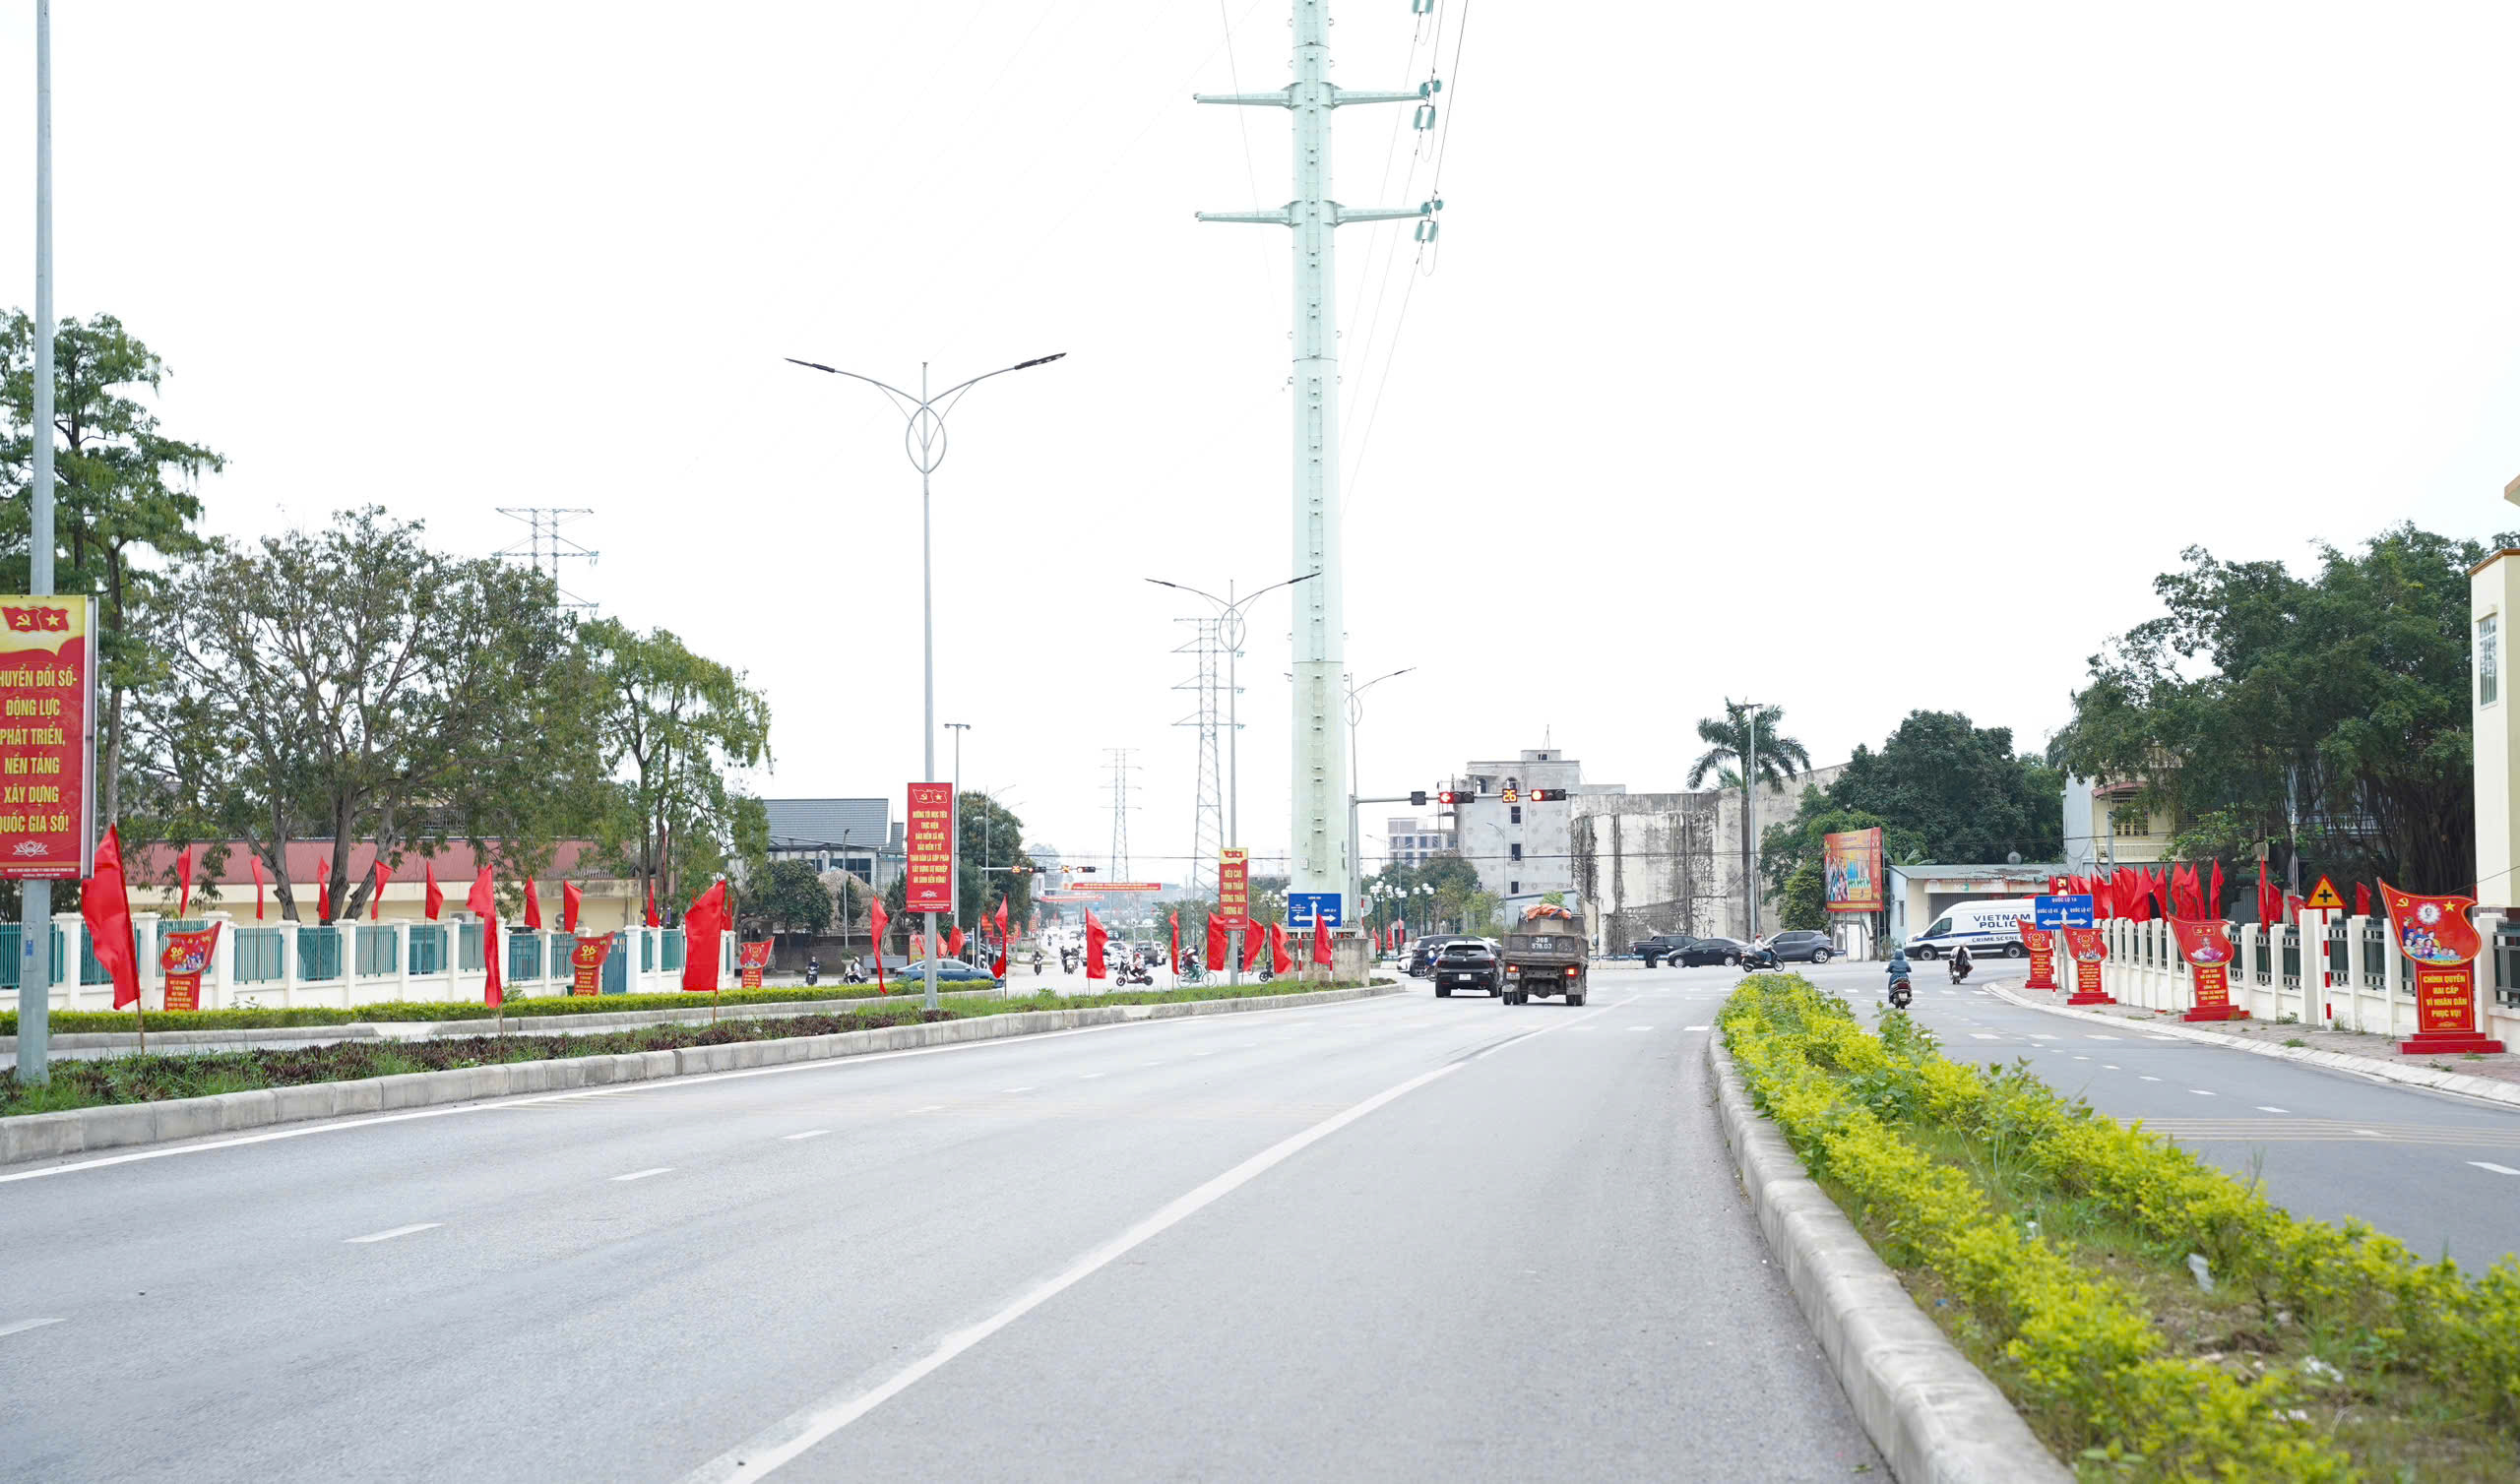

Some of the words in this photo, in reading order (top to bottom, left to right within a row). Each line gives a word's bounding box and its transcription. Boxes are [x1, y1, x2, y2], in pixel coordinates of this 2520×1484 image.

[0, 663, 33, 687] HUYỂN
[36, 663, 55, 687] ĐỔI
[6, 696, 36, 720] ĐỘNG
[39, 697, 60, 720] LỰC
[0, 725, 28, 745] PHÁT
[31, 721, 66, 747] TRIỂN,
[5, 752, 29, 774] NỀN
[31, 751, 60, 774] TẢNG
[4, 784, 27, 803] XÂY
[29, 786, 59, 807] DỰNG
[1503, 789, 1517, 802] 26
[29, 815, 47, 833] GIA
[50, 810, 69, 833] SỐ!
[2423, 975, 2443, 983] CHÍNH
